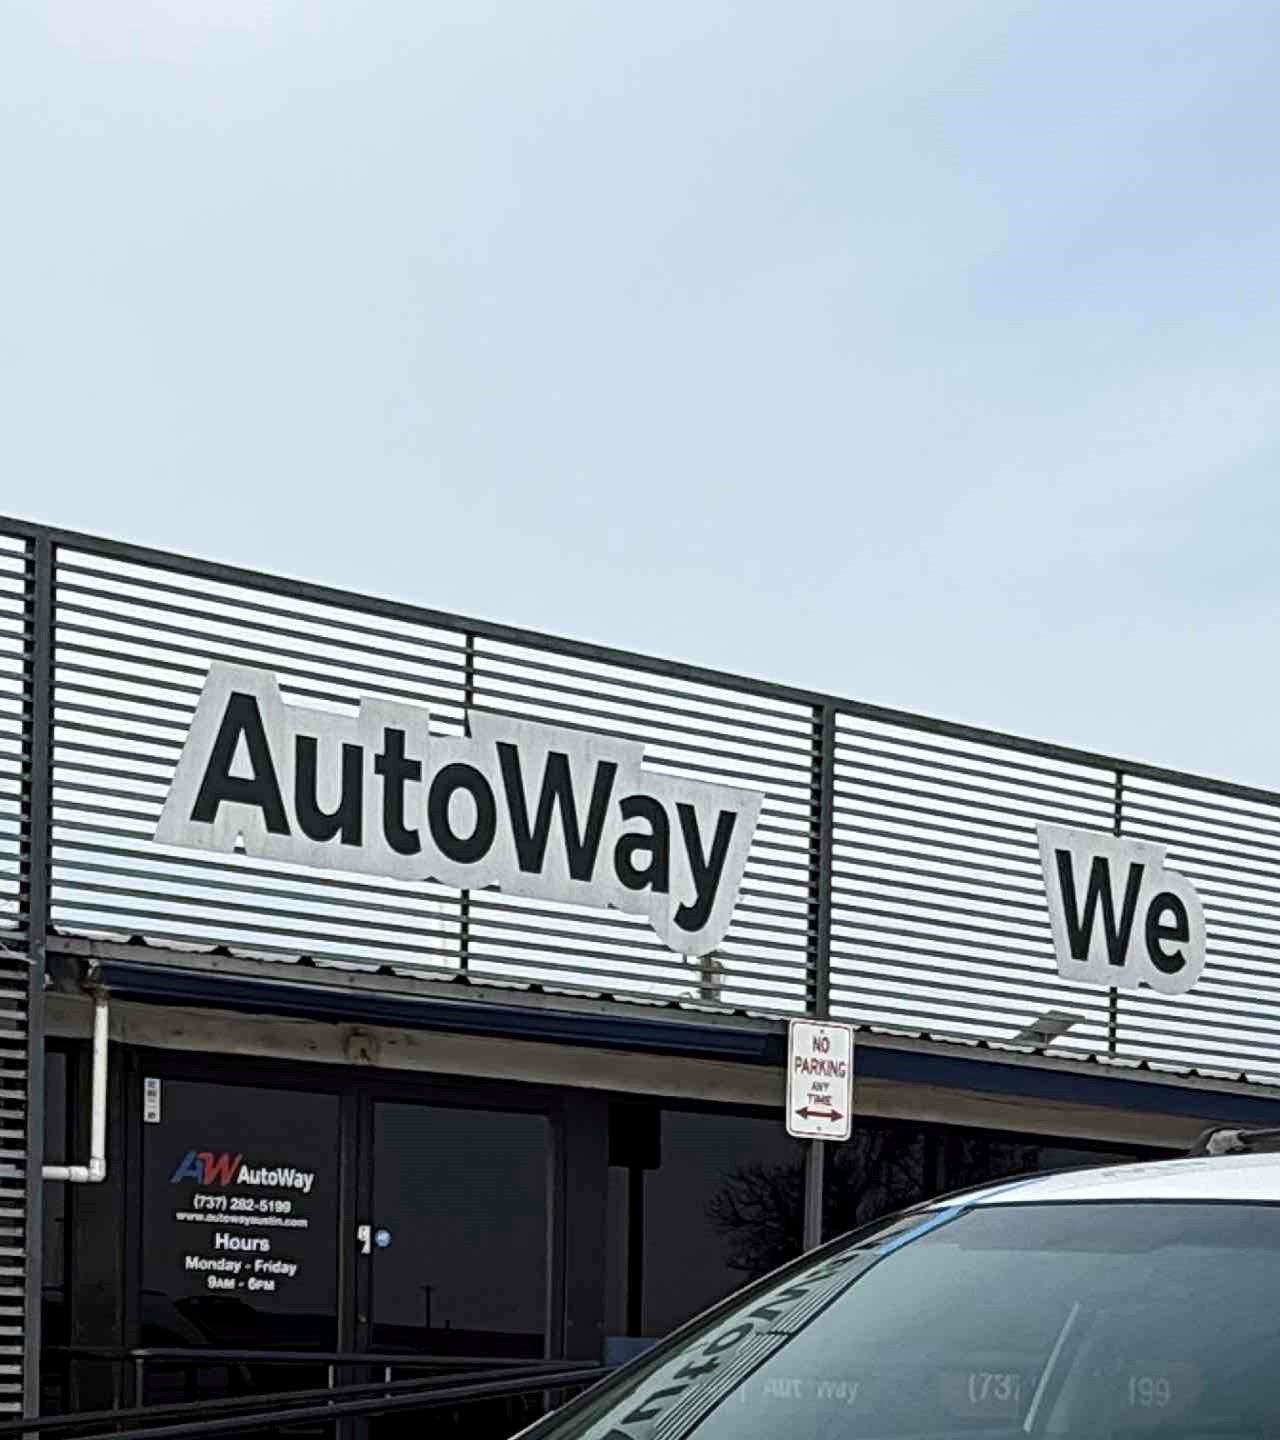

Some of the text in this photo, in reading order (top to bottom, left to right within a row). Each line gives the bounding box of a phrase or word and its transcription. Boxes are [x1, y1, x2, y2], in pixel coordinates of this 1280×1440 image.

[190, 692, 736, 932] AutoWay
[1055, 849, 1190, 974] We
[813, 1037, 830, 1054] NO
[795, 1056, 846, 1078] PARKING
[811, 1081, 829, 1092] ANY
[807, 1094, 832, 1105] TIME
[171, 1151, 315, 1192] AW AutoWay
[193, 1194, 228, 1211] (737)
[215, 1232, 271, 1251] Hours
[185, 1256, 242, 1273] Monday
[254, 1259, 297, 1277] Friday
